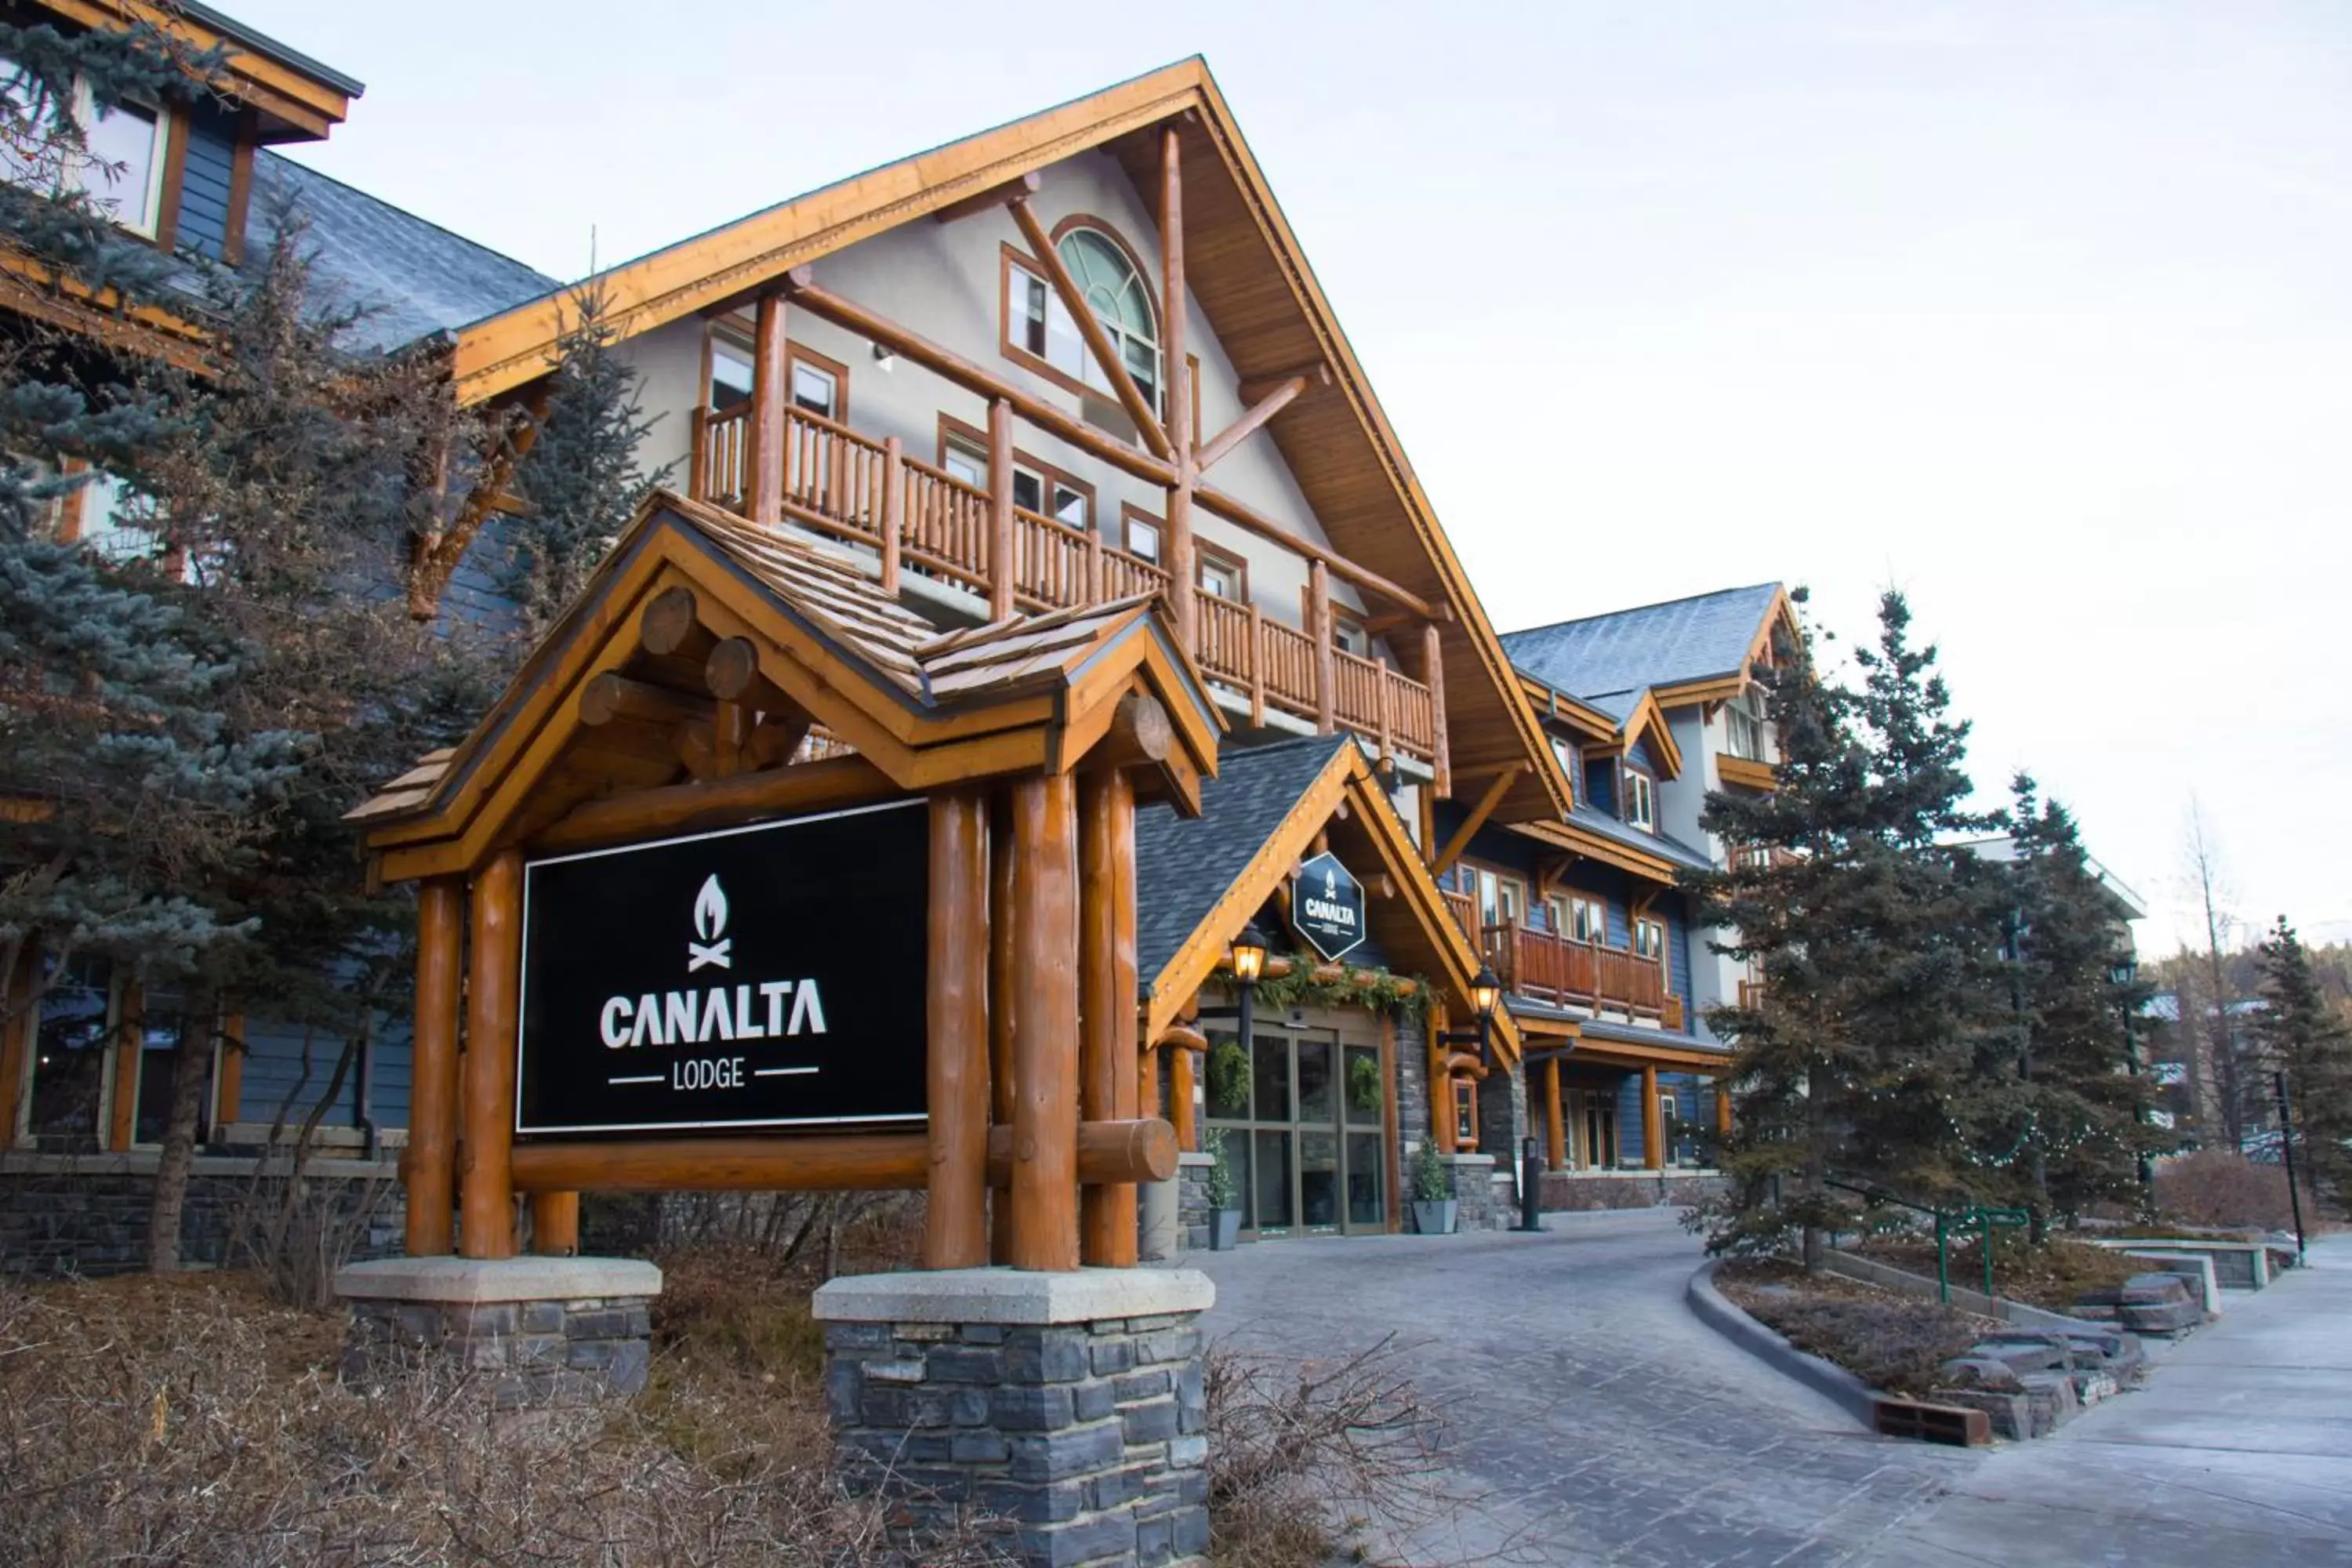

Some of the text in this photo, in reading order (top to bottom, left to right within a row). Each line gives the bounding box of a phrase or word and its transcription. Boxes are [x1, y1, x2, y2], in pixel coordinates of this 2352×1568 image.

[1305, 898, 1356, 926] CANALTA
[600, 978, 827, 1049] CANALTA
[673, 1057, 746, 1091] LODGE
